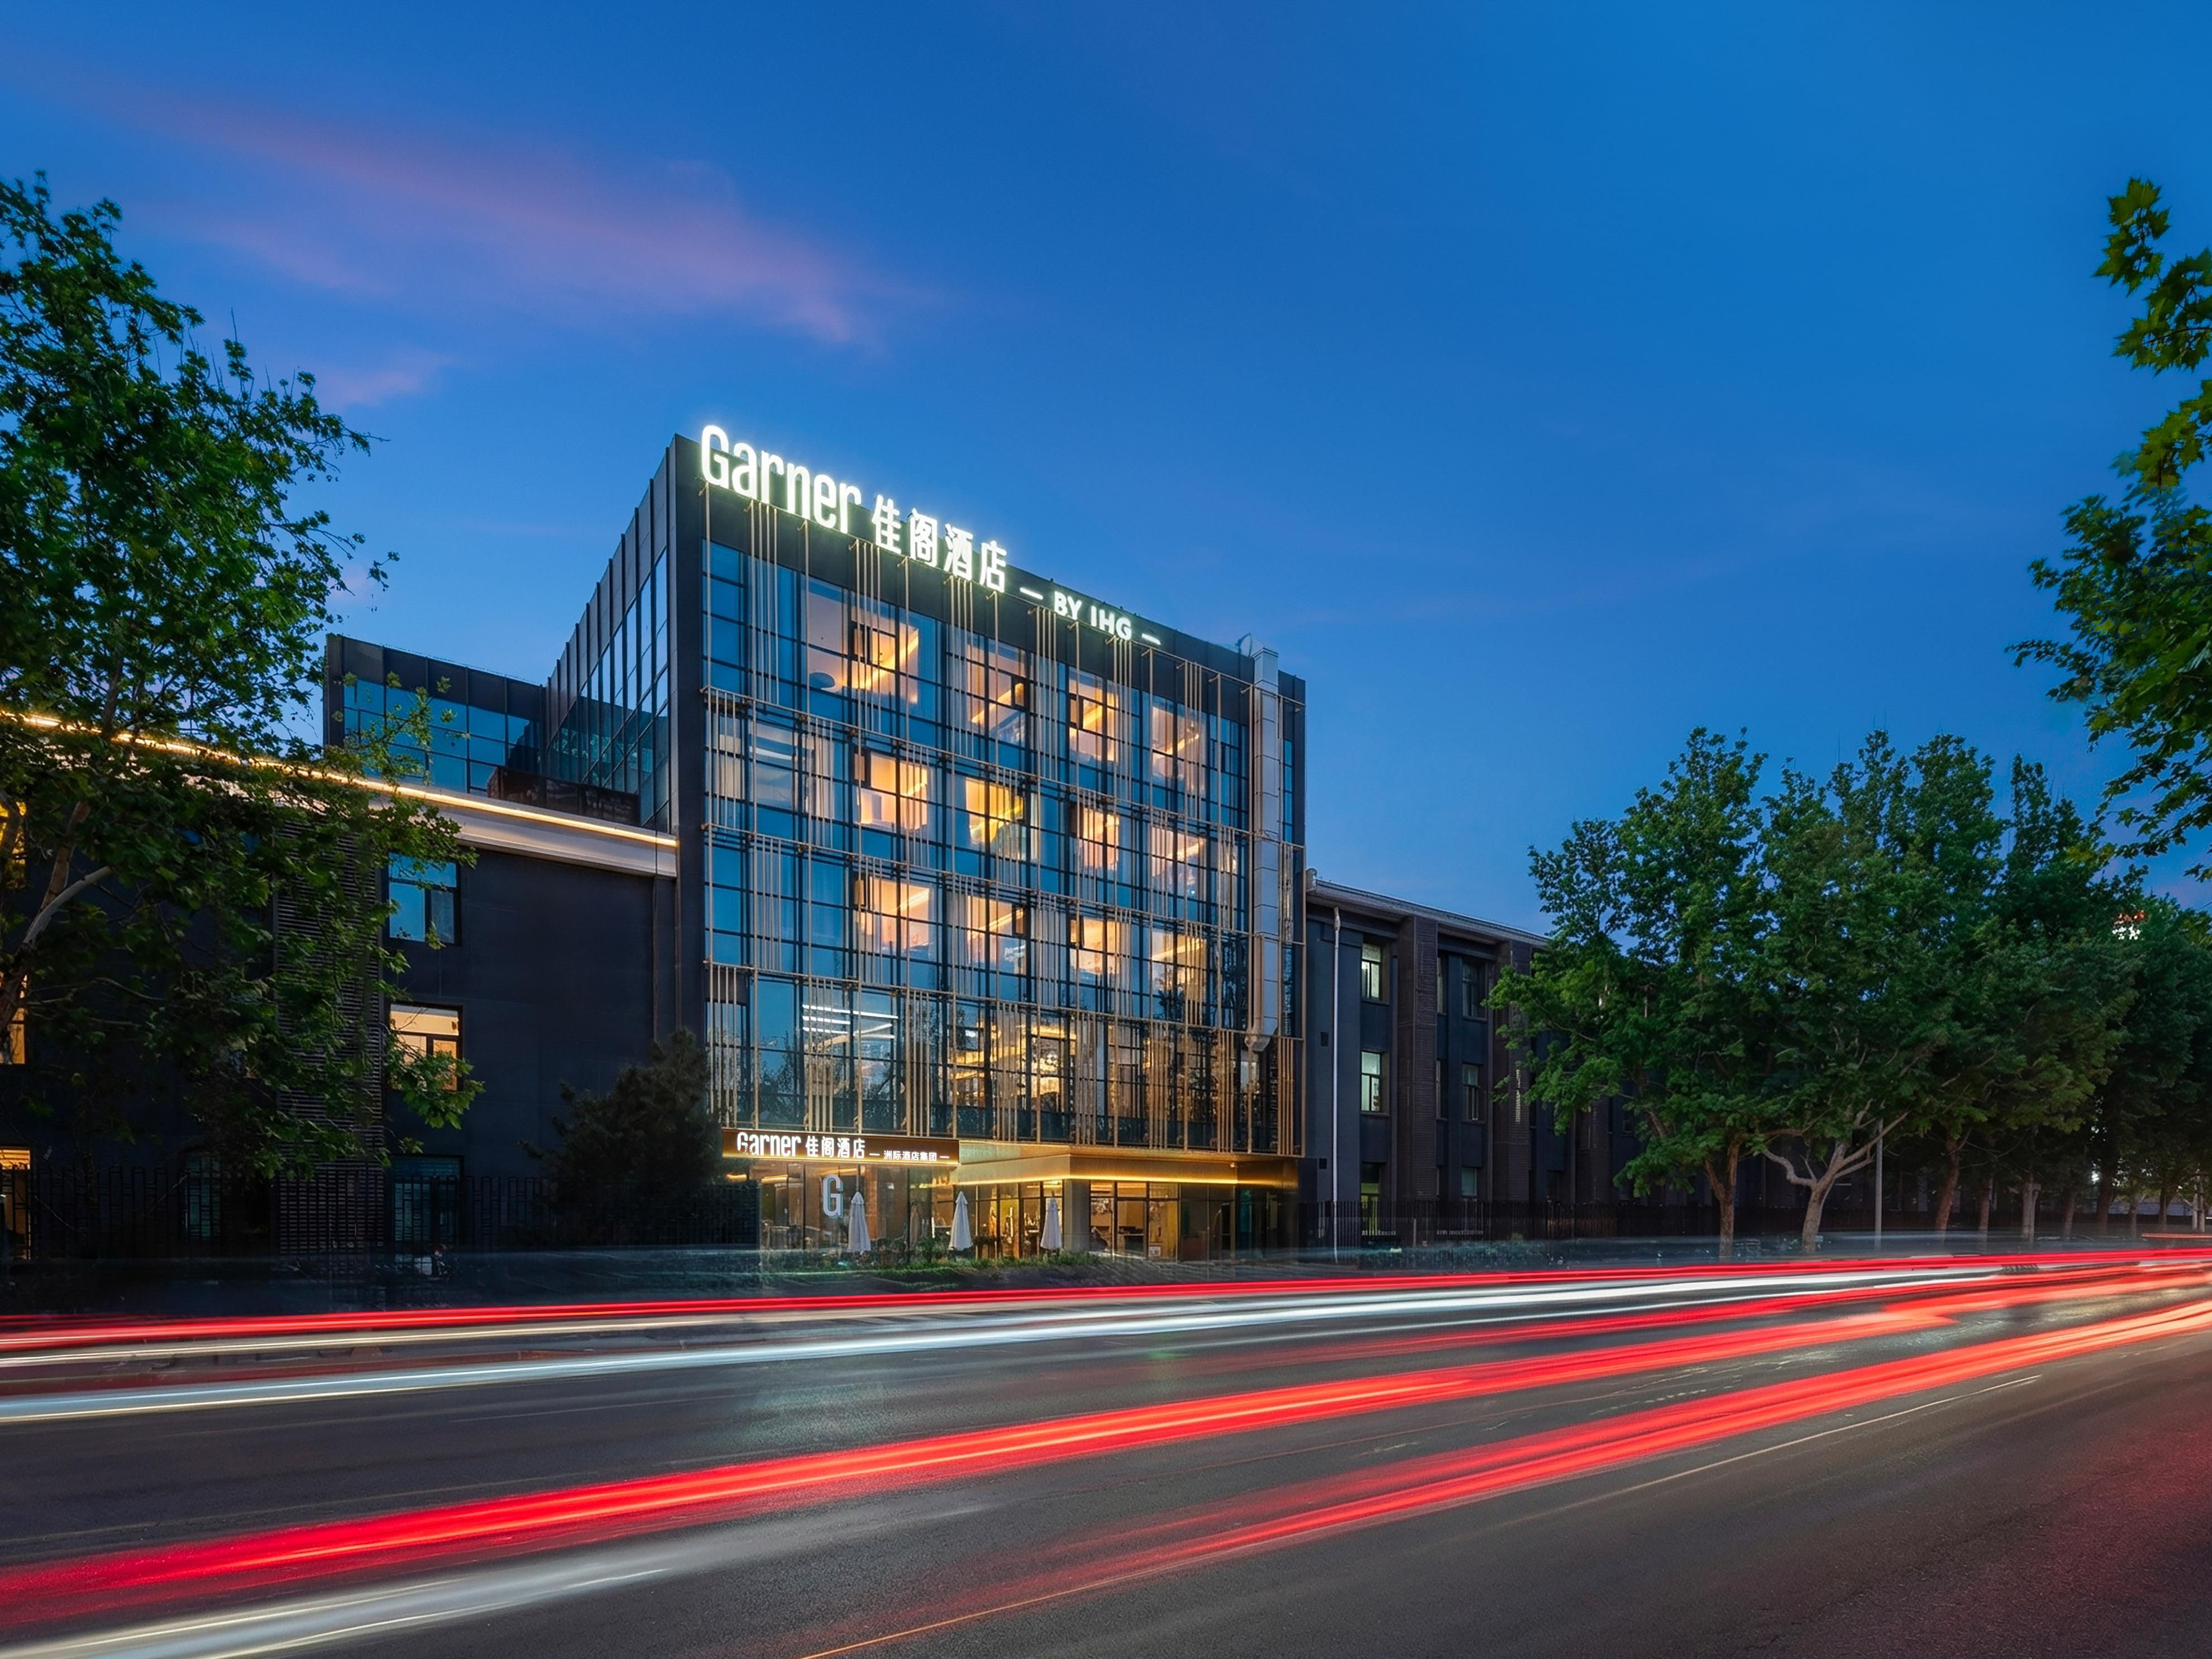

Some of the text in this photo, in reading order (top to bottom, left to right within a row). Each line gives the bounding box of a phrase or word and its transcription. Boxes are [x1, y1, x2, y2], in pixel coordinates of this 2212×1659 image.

[701, 425, 1132, 640] Garner 佳阁酒店 BY IHG
[737, 1132, 937, 1161] Garner 佳阁酒店 洲际酒店集团
[823, 1174, 843, 1219] G
